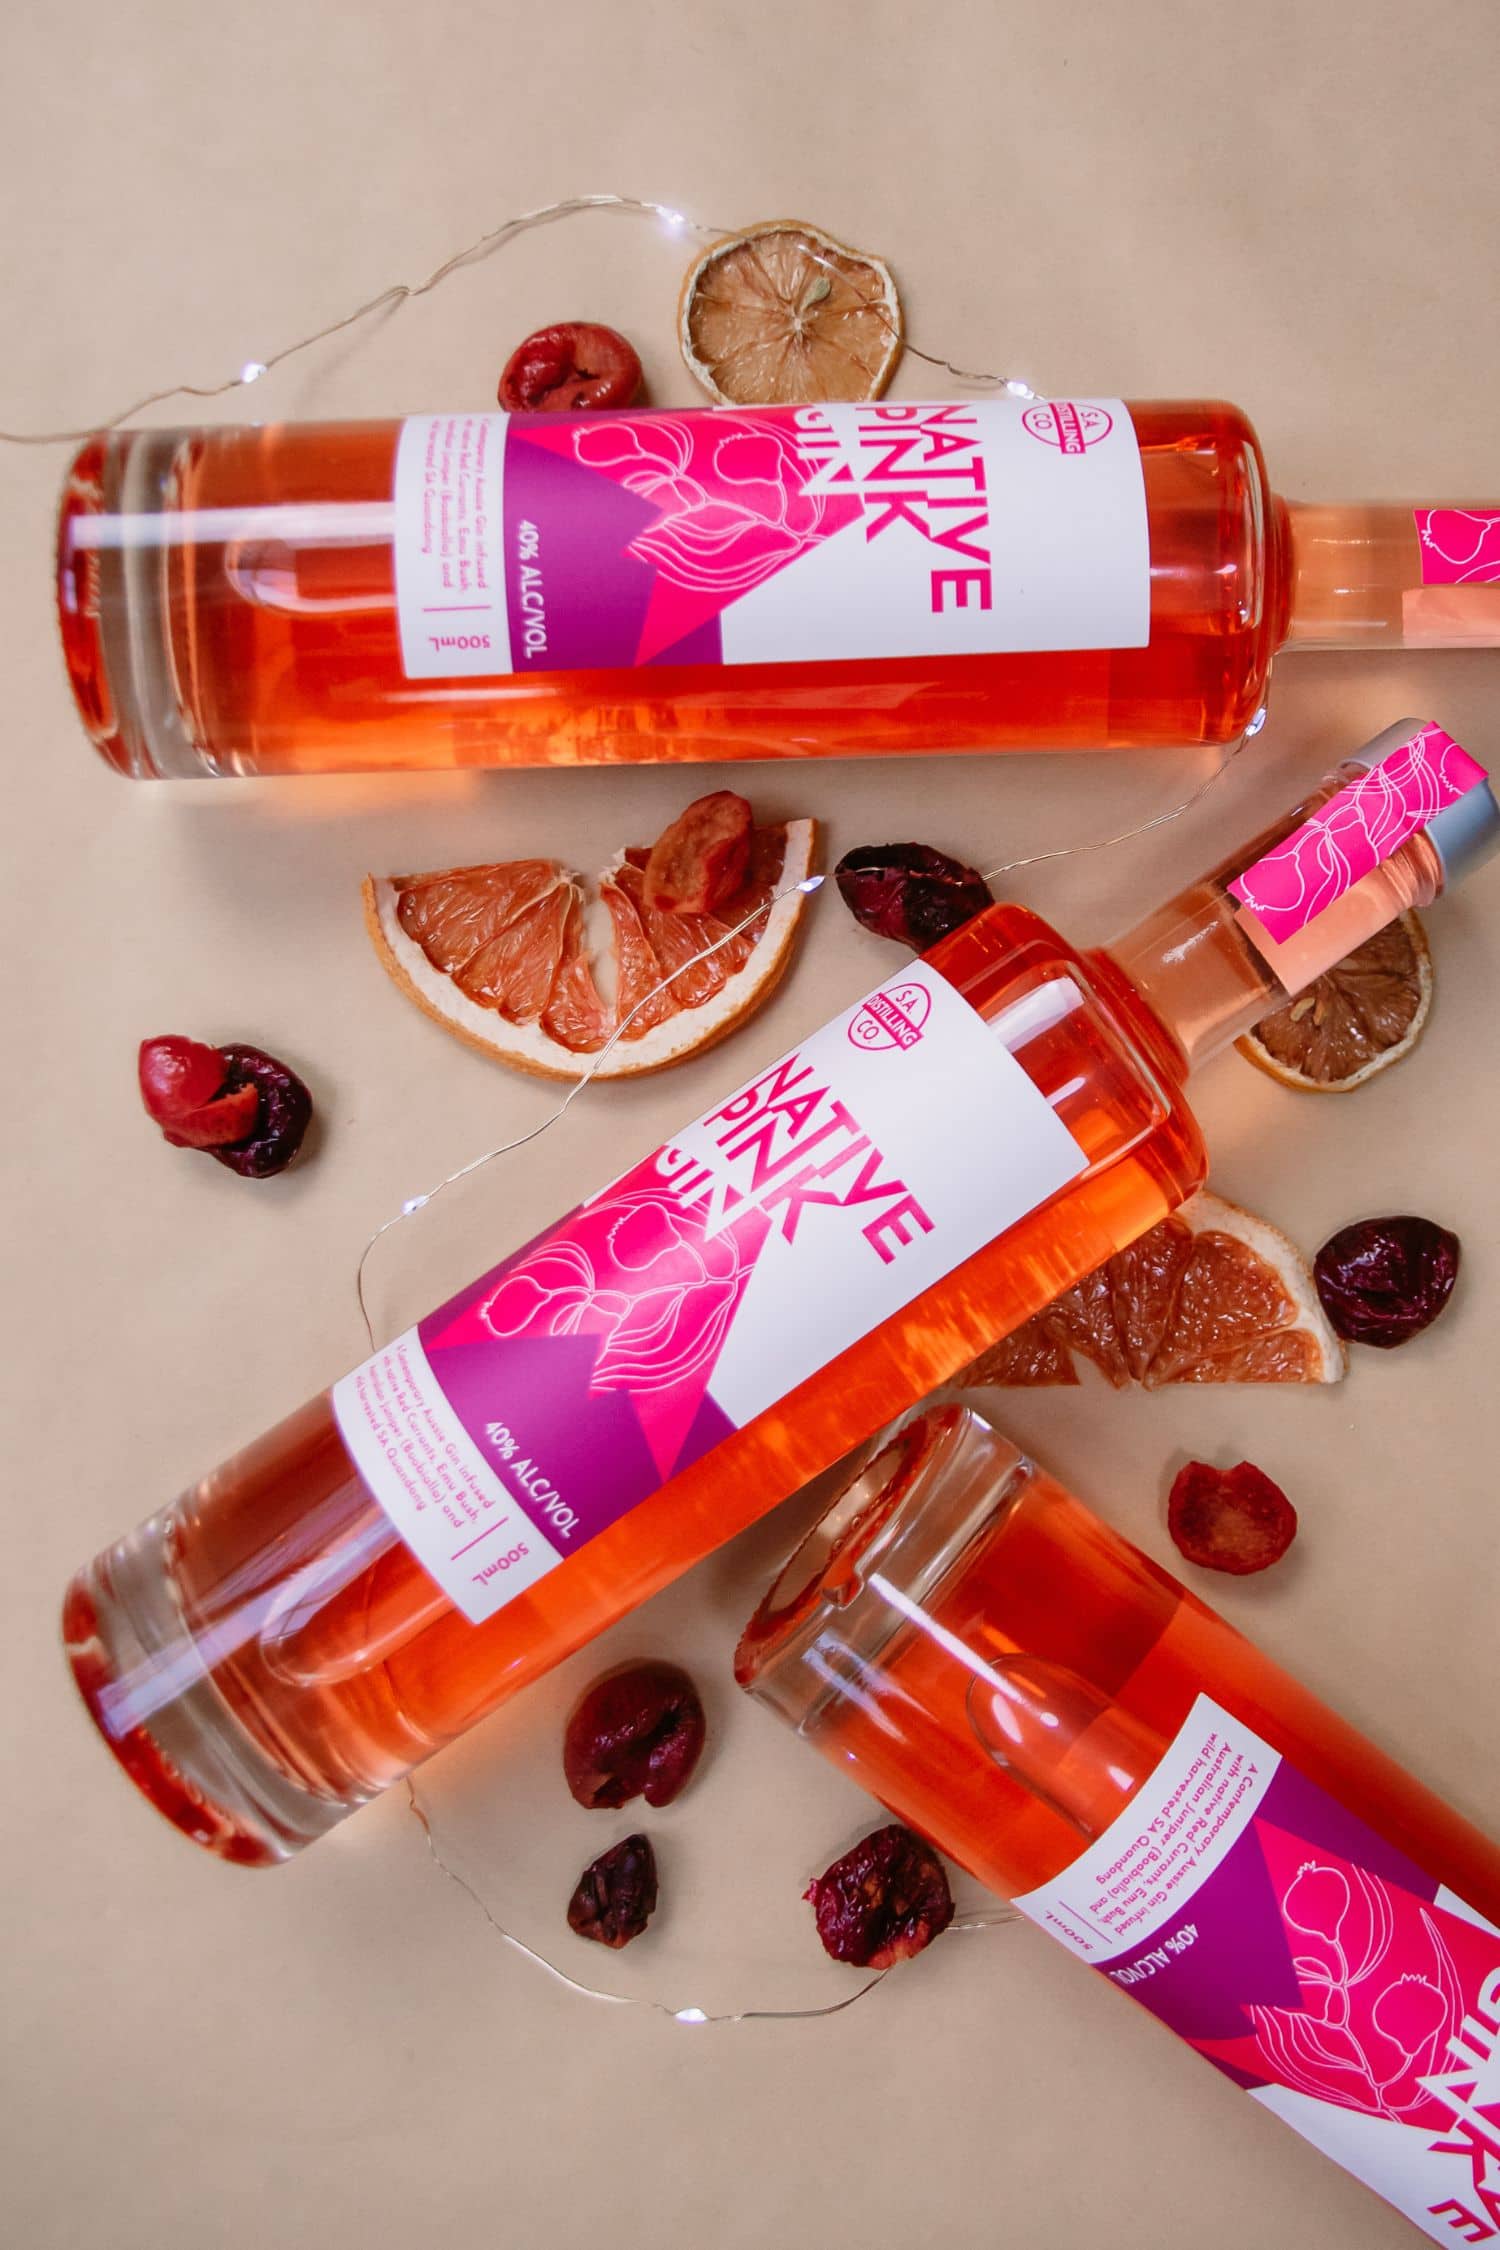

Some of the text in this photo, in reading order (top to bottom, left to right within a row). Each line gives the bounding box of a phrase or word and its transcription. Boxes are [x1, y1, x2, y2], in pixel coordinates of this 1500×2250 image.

[794, 406, 863, 495] GIN
[855, 405, 930, 543] PINK
[918, 404, 992, 613] NATIVE
[517, 519, 547, 658] 40% ALC/VOL
[430, 634, 491, 651] 500mL
[866, 995, 918, 1045] DISTILLING
[655, 1129, 757, 1242] GIN
[703, 1086, 842, 1246] PINK
[755, 1052, 936, 1266] NATIVE
[435, 1462, 456, 1492] Emu
[443, 1441, 460, 1464] Gin
[458, 1466, 494, 1510] infused
[485, 1421, 579, 1537] 40% ALC/VOL
[441, 1505, 465, 1529] and
[471, 1542, 529, 1585] 500mL
[1203, 1779, 1230, 1816] native
[1226, 1753, 1244, 1778] with
[1089, 1743, 1232, 1913] Australian Juniper (Boobialla) and
[1094, 1732, 1217, 1885] wild harvested SA Quandong
[1185, 1816, 1209, 1842] Red
[1114, 1764, 1258, 1936] A Contemporary Aussie Gin infused
[1143, 1841, 1189, 1886] Currants,
[1121, 1886, 1148, 1907] Emu
[1164, 1923, 1199, 1954] 40%
